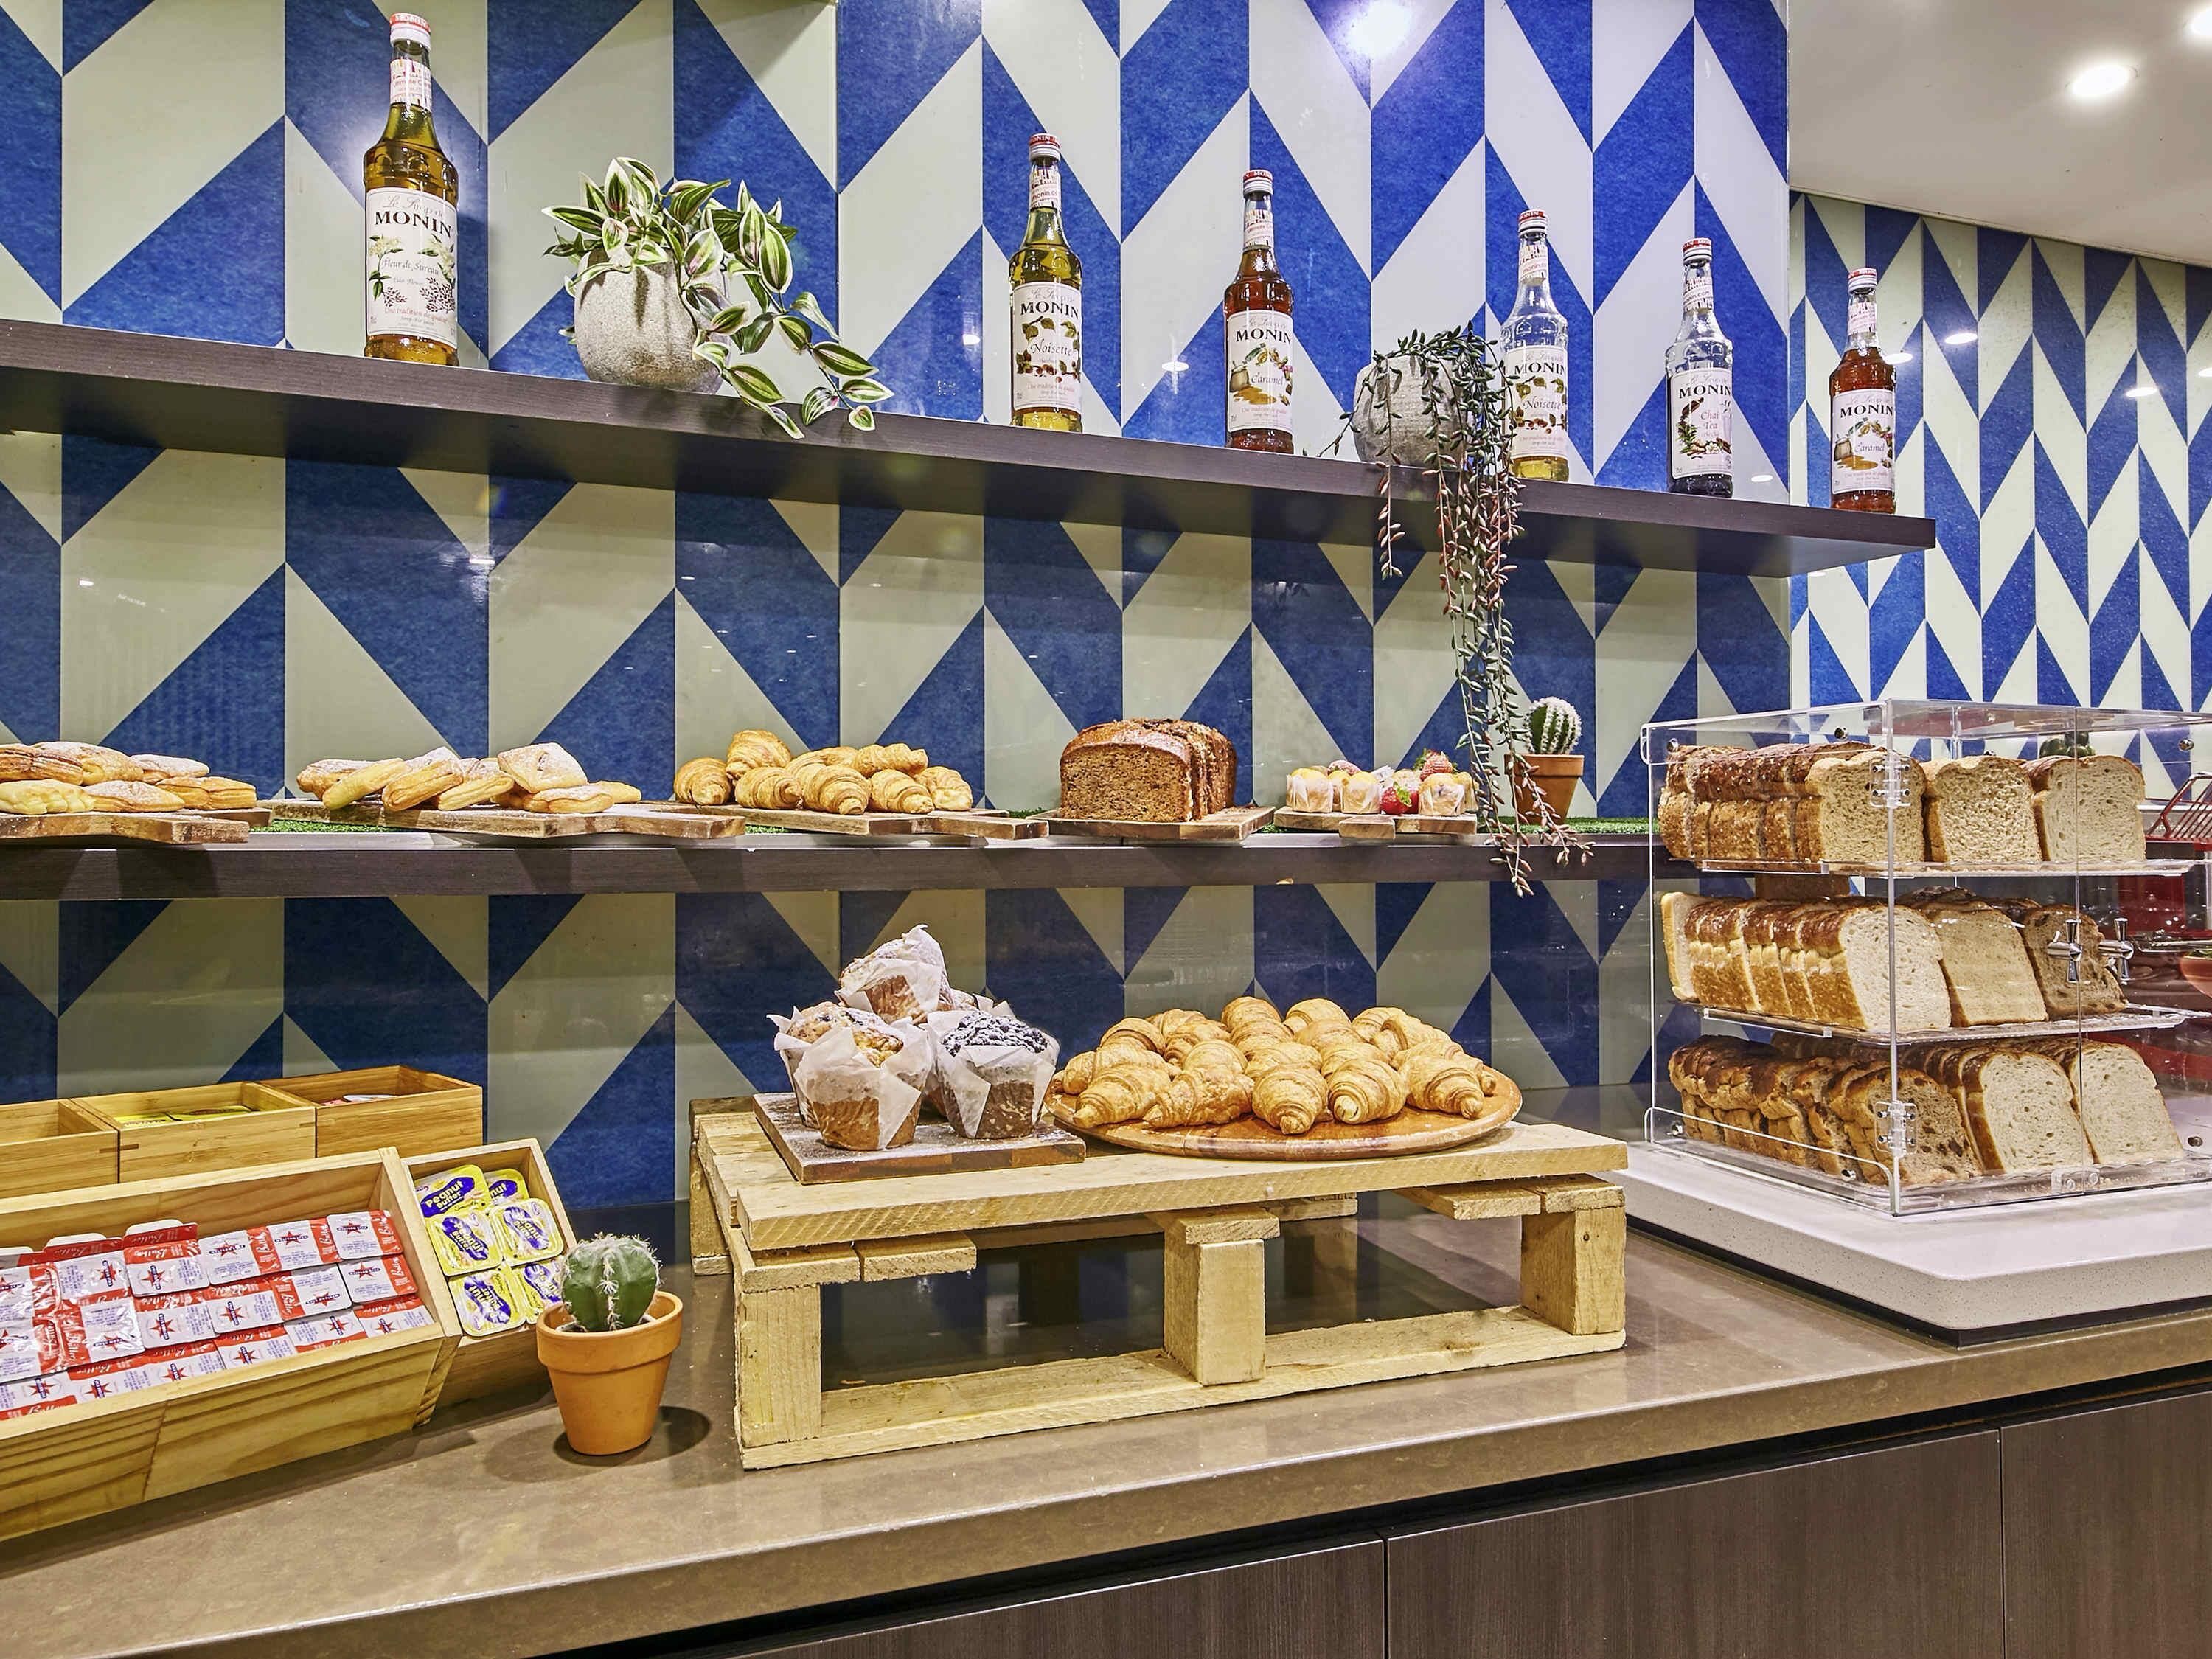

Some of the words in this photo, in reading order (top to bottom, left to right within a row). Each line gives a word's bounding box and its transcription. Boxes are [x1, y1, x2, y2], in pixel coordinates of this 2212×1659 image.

[375, 210, 451, 240] MONIN
[1020, 301, 1079, 320] MONIN
[1235, 328, 1290, 344] MONIN
[1030, 338, 1072, 357] Noisette
[1514, 362, 1565, 375] MONIN
[1251, 372, 1284, 386] Caramel
[1679, 384, 1731, 399] MONIN
[1523, 396, 1561, 411] Noisette
[1840, 404, 1893, 418] MONIN
[425, 1180, 464, 1208] Peanut
[490, 1183, 507, 1199] nut
[437, 1191, 462, 1209] Butter
[451, 1230, 471, 1252] Butter
[453, 1220, 484, 1253] Peanut
